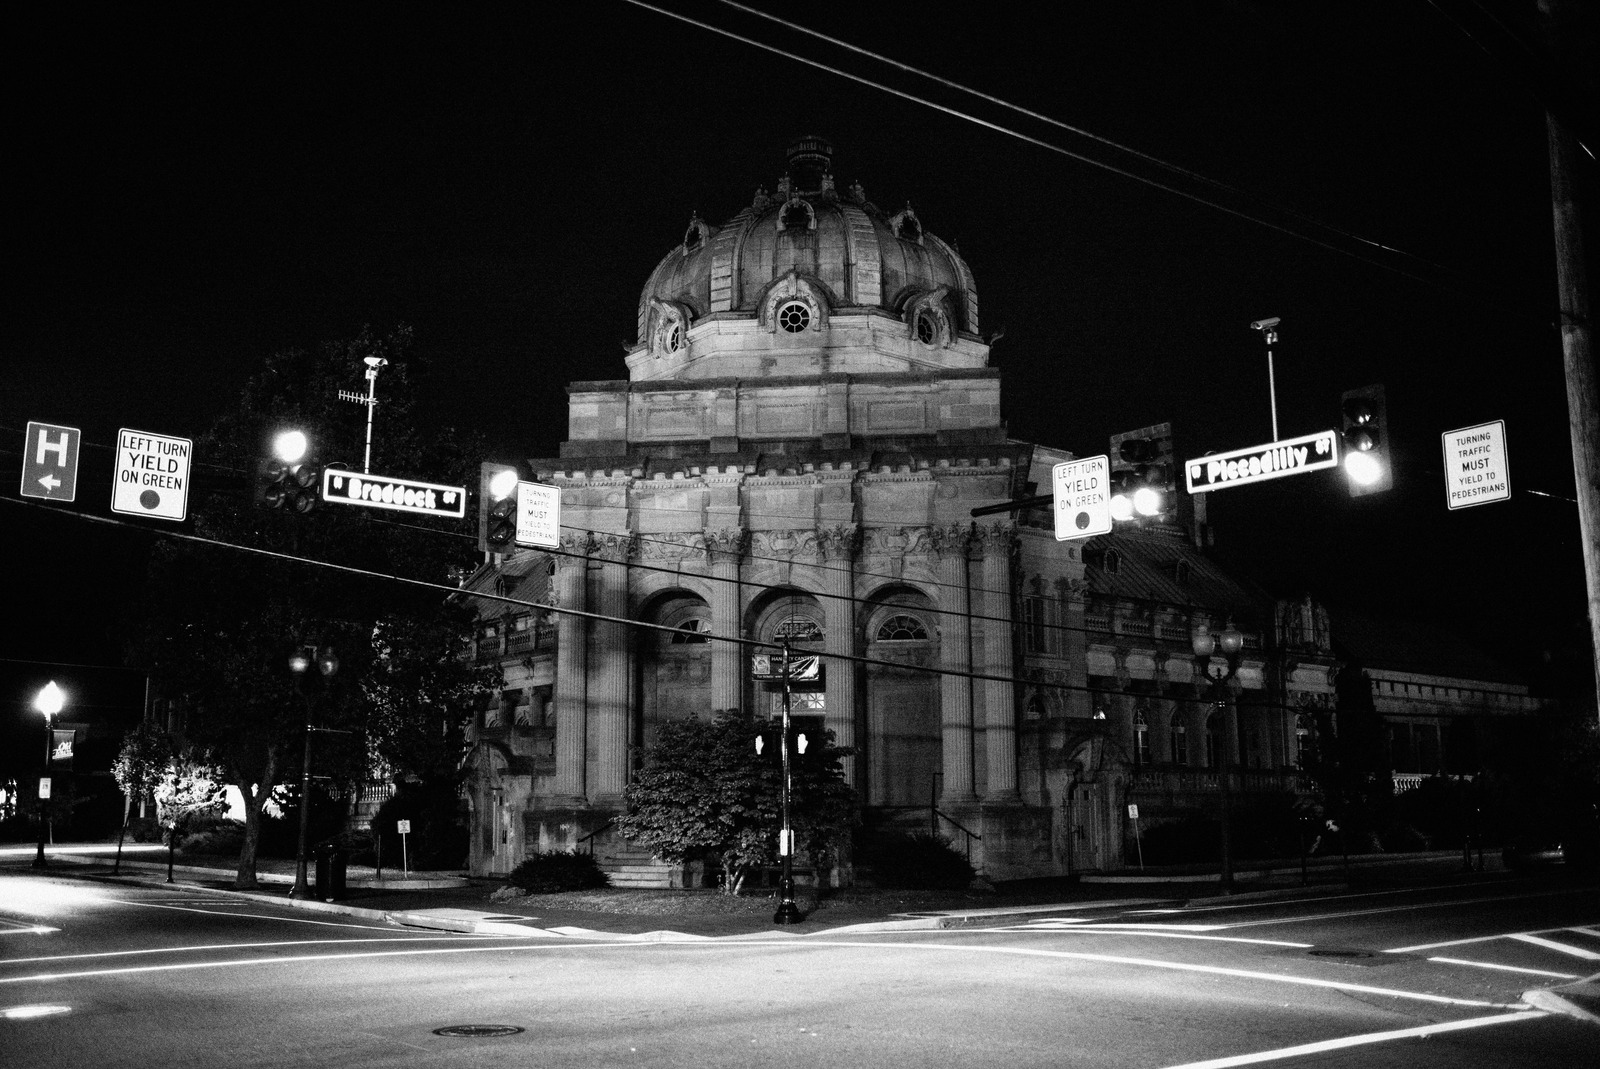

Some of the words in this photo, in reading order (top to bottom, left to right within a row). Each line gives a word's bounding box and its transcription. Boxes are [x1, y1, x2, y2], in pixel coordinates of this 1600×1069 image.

[122, 435, 152, 452] LEFT
[156, 440, 188, 458] TURN
[1456, 432, 1491, 446] TURNING
[36, 429, 69, 468] H
[1458, 445, 1491, 458] TRAFFIC
[128, 452, 178, 473] YIELD
[1058, 465, 1077, 479] LEFT
[1081, 461, 1103, 474] TURN
[1207, 446, 1308, 484] Piccadilly
[1462, 457, 1490, 472] MUST
[121, 469, 139, 484] ON
[142, 473, 182, 490] GREEN
[1064, 477, 1098, 494] YIELD
[1459, 474, 1483, 485] YIELD
[1486, 471, 1496, 480] TO
[348, 477, 436, 509] Braddock
[526, 489, 551, 499] TURNING
[1452, 482, 1505, 499] PEDESTRIANS
[526, 498, 550, 509] TRAFFIC
[1060, 499, 1071, 510] ON
[1075, 493, 1104, 507] GREEN
[527, 509, 548, 519] MUST
[525, 519, 542, 529] YIELD
[543, 522, 551, 530] TO
[517, 528, 556, 541] PEDESTRIANS
